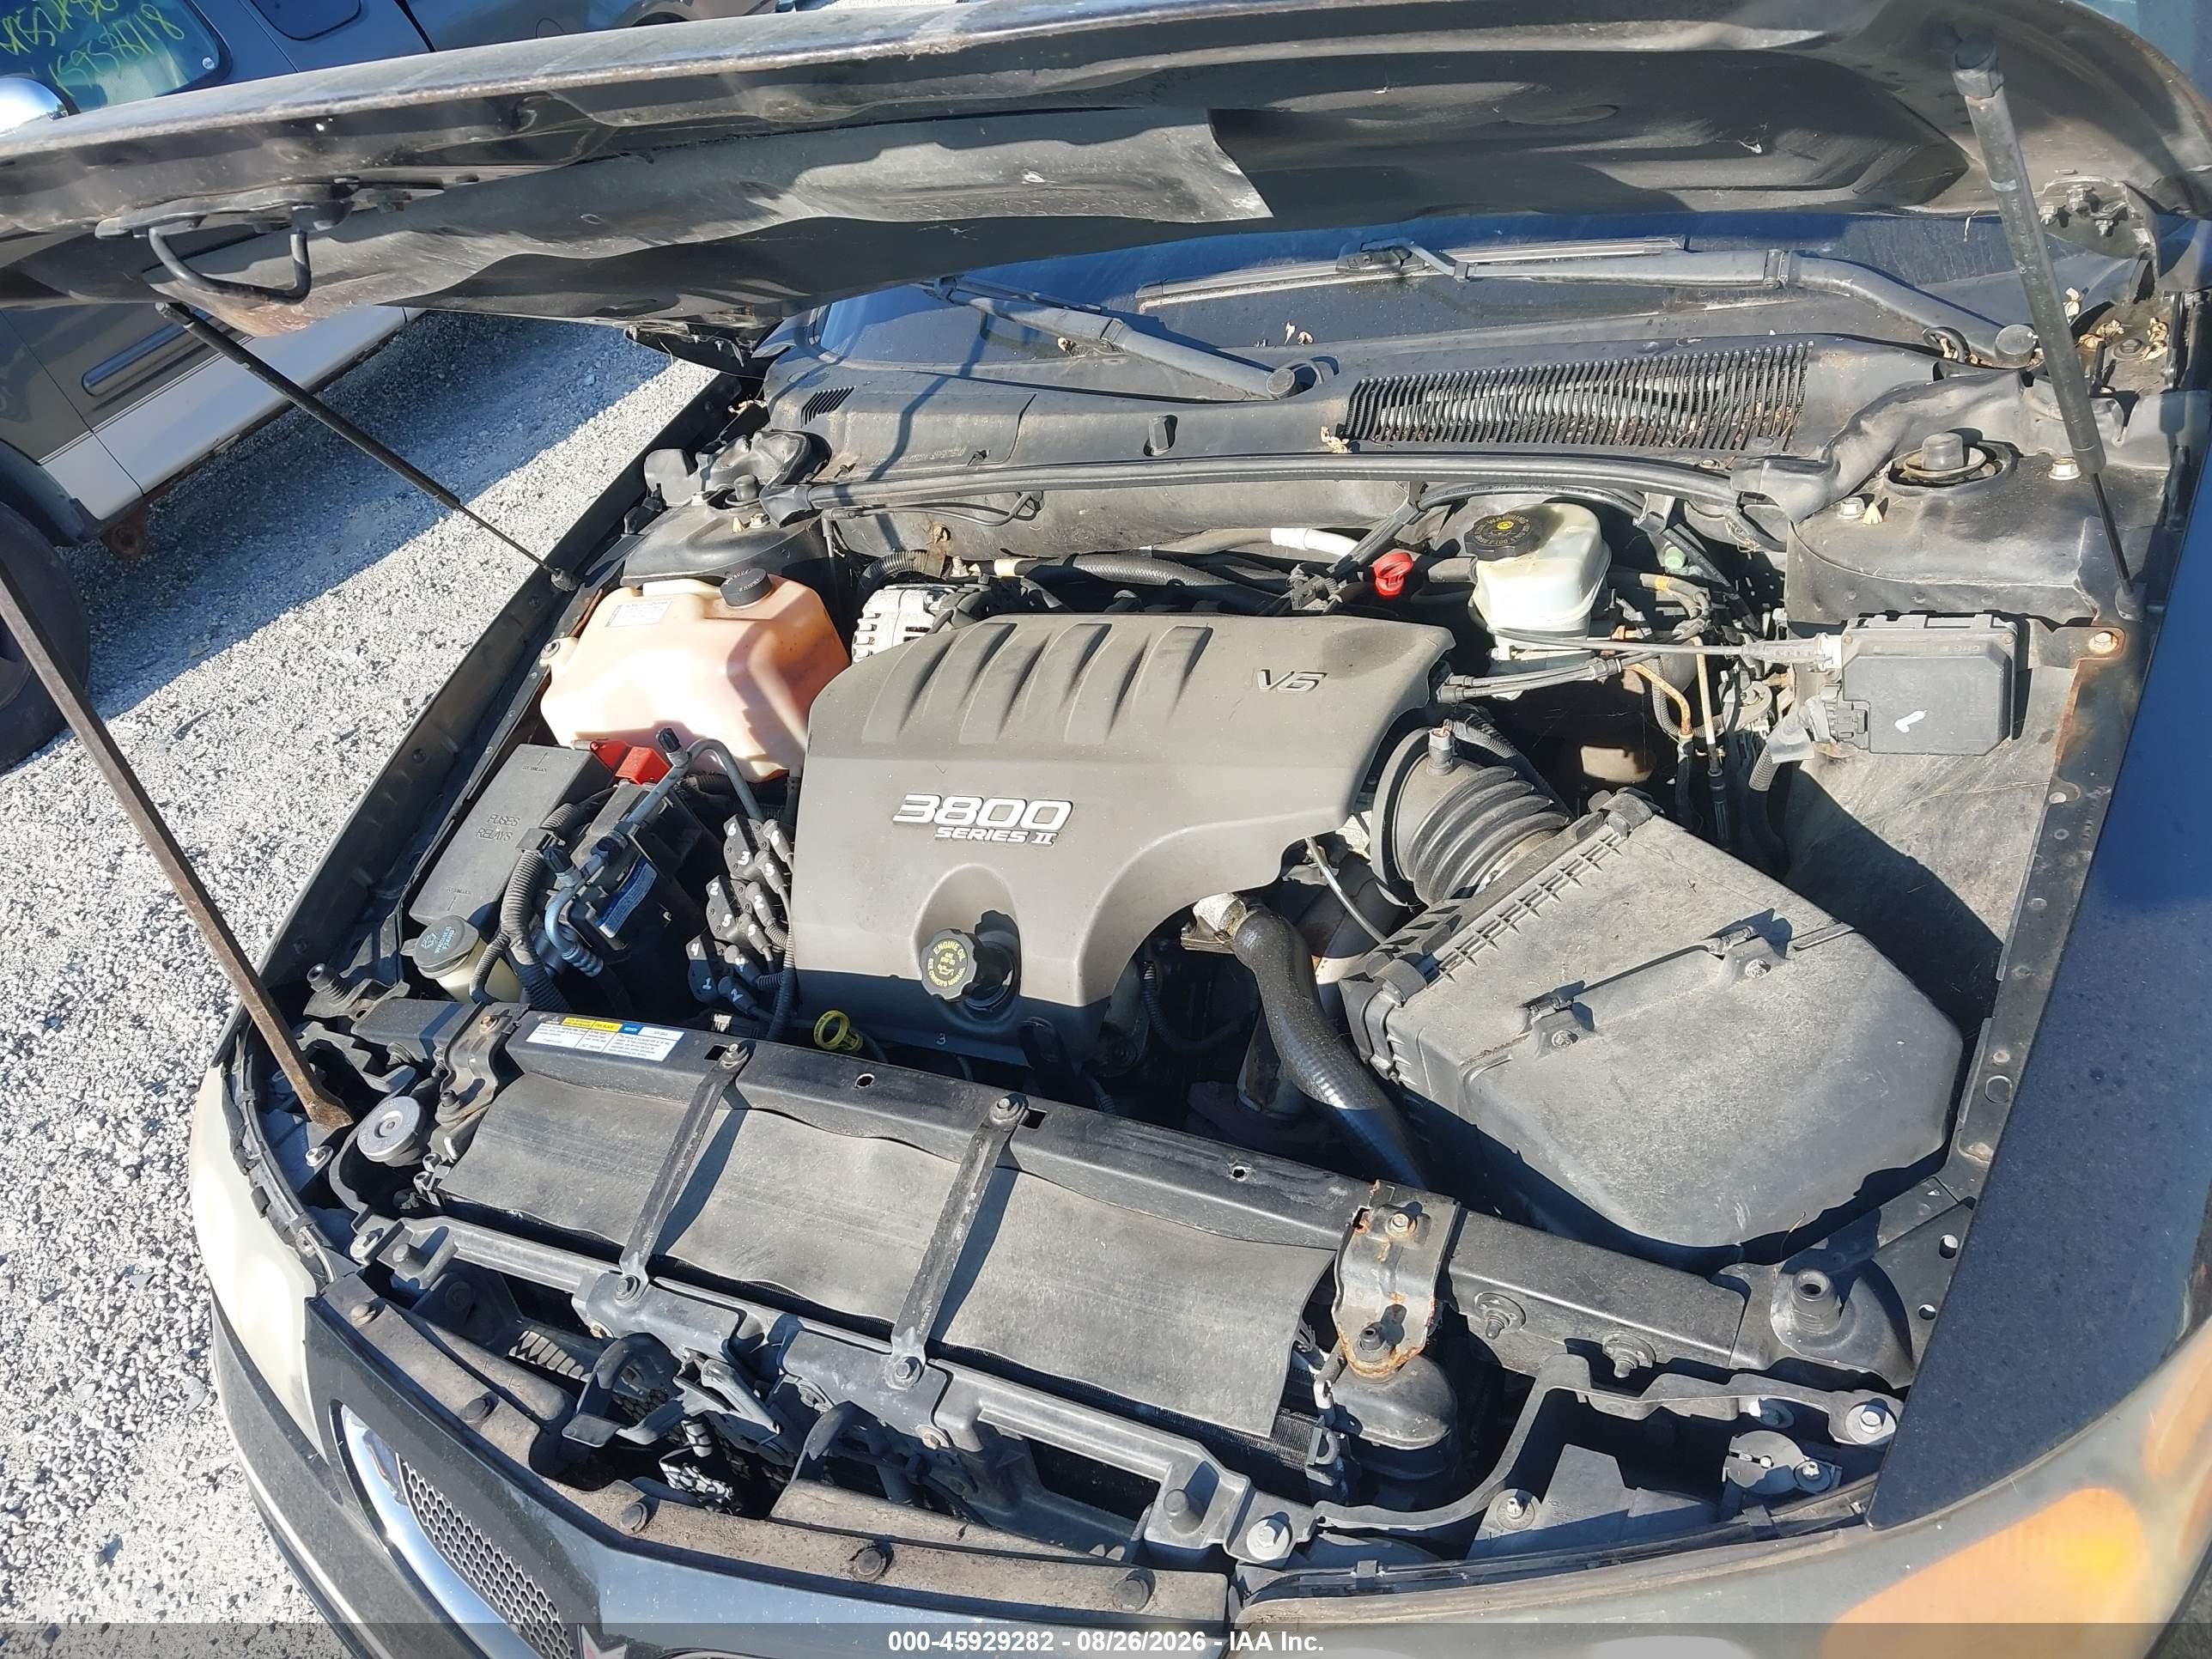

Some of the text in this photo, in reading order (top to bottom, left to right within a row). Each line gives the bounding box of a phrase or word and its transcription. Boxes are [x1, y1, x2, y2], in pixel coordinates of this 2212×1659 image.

[1256, 669, 1328, 693] V6
[892, 793, 1074, 831] 3800
[487, 813, 520, 827] FUSES
[475, 827, 514, 842] RELAYS
[727, 823, 737, 836] 6
[934, 827, 1060, 846] SERIES II
[738, 851, 750, 866] 3
[709, 882, 720, 896] 2
[755, 895, 764, 909] 2
[721, 913, 732, 927] 5
[690, 943, 700, 957] 4
[933, 940, 967, 963] ENGINE OIL
[702, 977, 712, 989] 1
[730, 988, 744, 1002] 2
